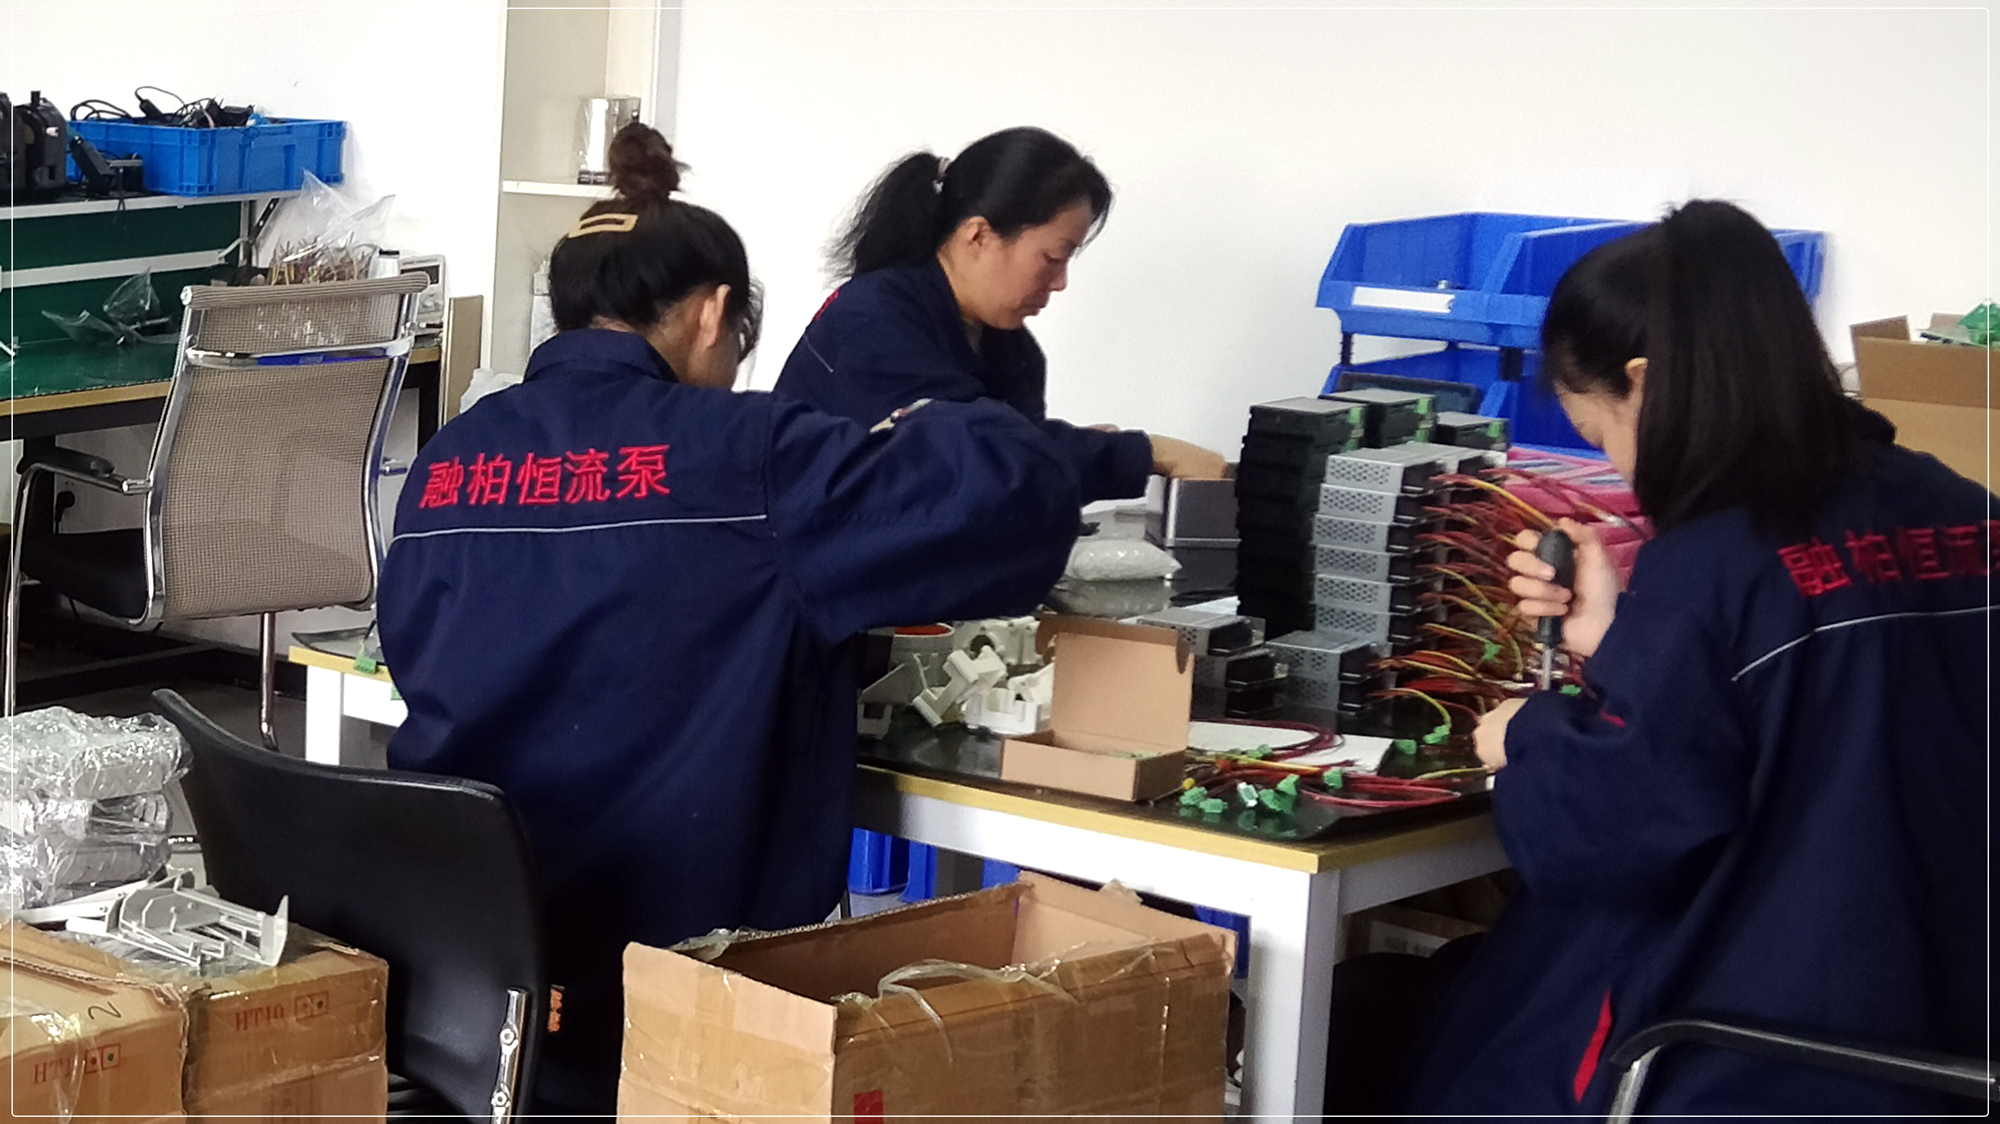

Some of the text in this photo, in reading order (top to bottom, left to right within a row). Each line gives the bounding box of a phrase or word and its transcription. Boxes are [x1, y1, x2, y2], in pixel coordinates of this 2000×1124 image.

[418, 444, 670, 508] 融柏恒流泵
